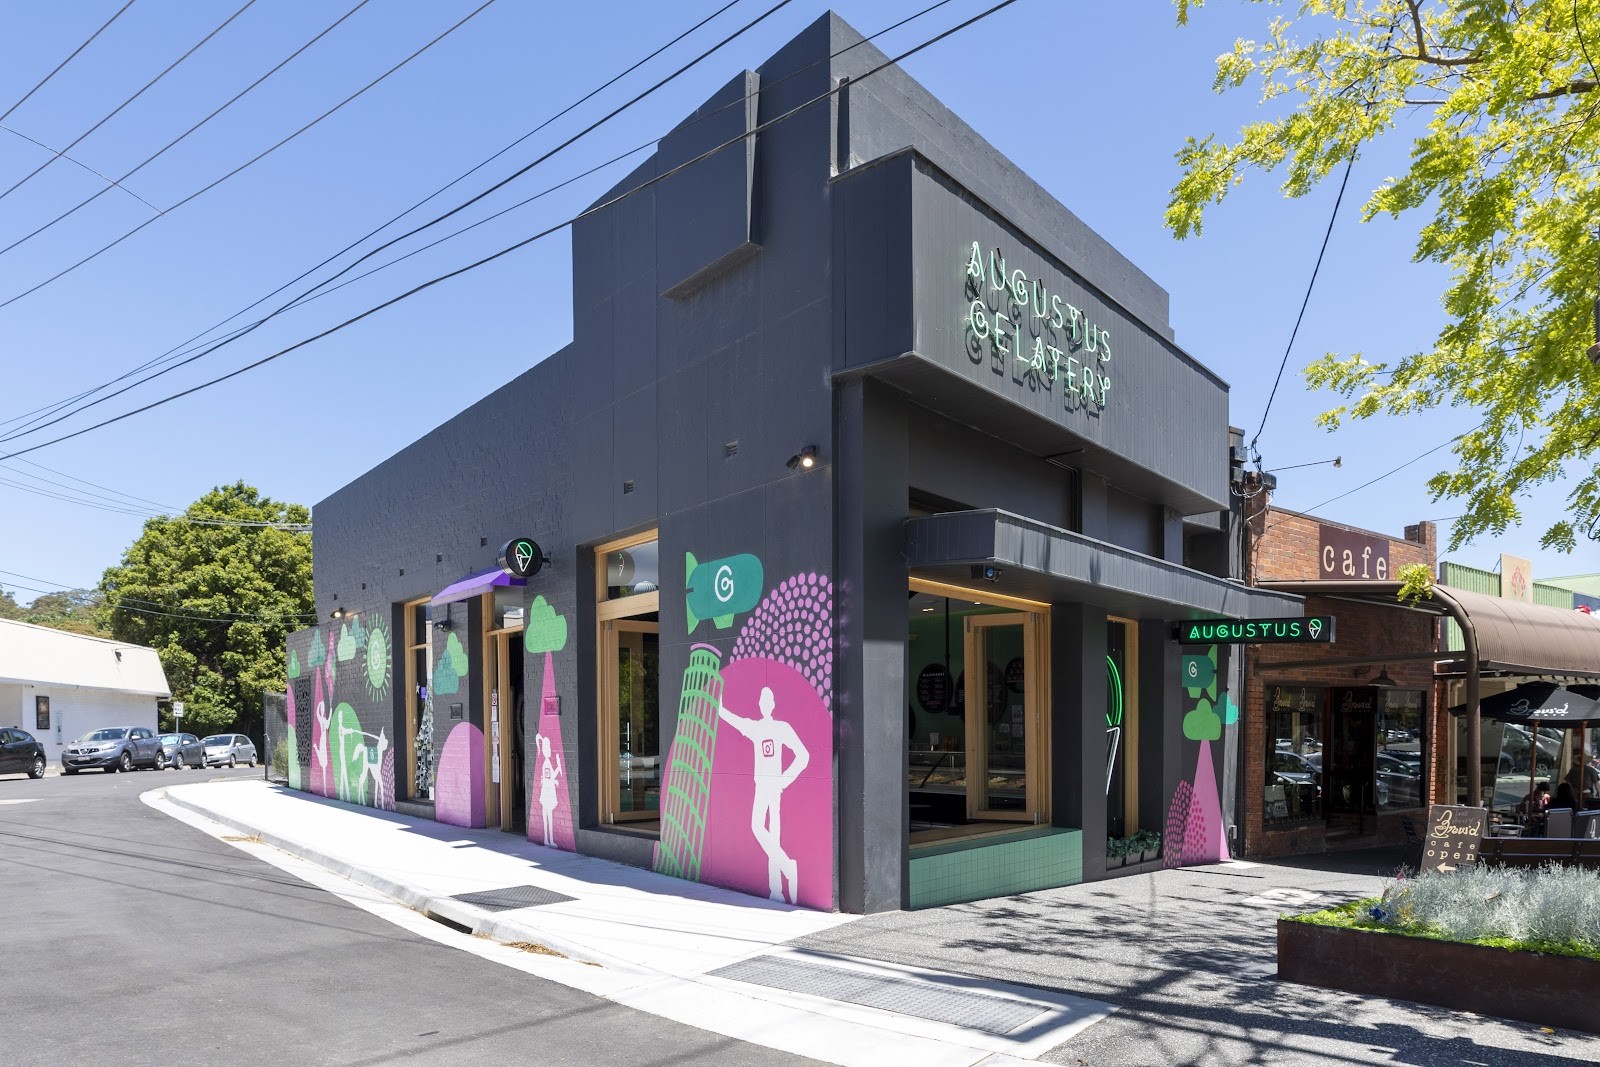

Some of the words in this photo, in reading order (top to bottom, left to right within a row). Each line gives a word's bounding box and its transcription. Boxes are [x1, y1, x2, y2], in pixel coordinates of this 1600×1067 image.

[967, 241, 1111, 362] AUGUSTUS
[970, 300, 1111, 406] GELATERY
[1323, 545, 1387, 580] cafe
[1189, 622, 1300, 639] AUGUSTUS
[1427, 850, 1475, 861] open
[1430, 840, 1476, 850] cafe
